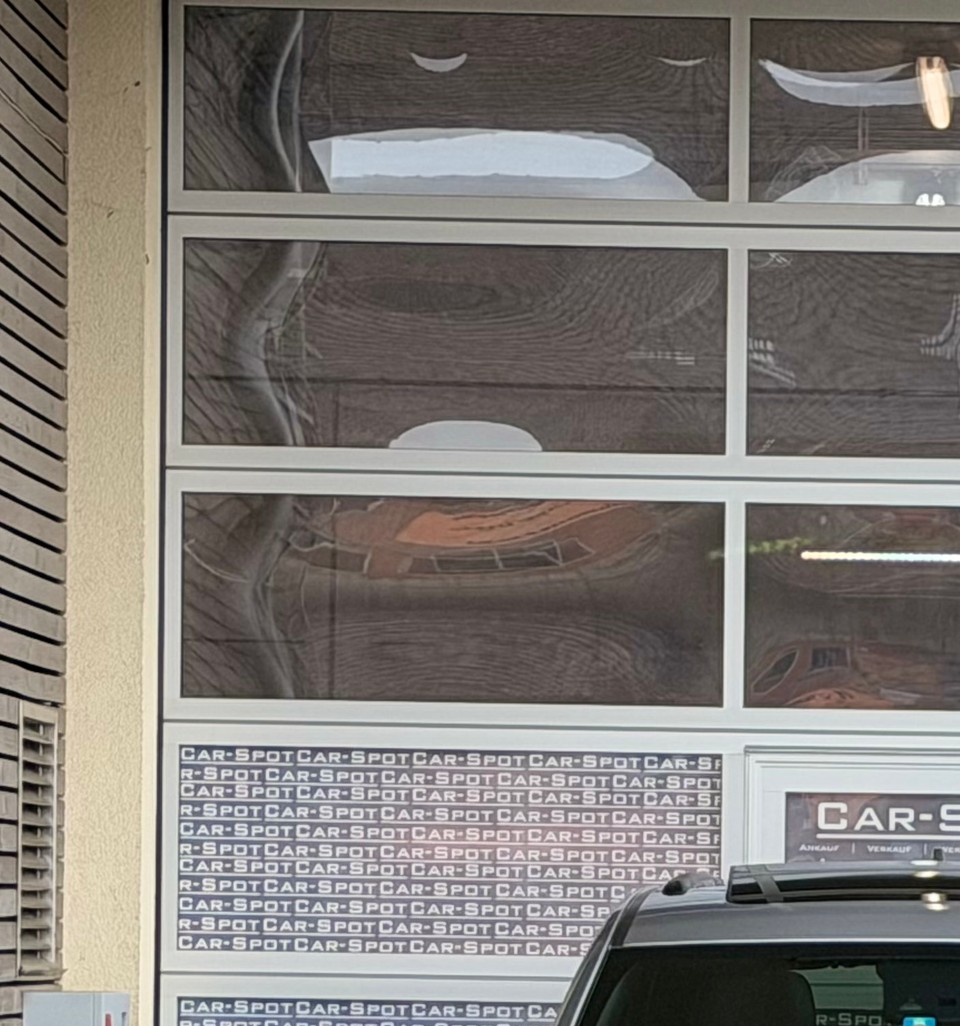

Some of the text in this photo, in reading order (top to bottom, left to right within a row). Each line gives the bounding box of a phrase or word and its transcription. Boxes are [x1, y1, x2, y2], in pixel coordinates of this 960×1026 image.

[181, 747, 294, 762] CAR-SPOT
[296, 749, 410, 764] CAR-SPOT
[412, 752, 526, 767] CAR-SPOT
[528, 754, 641, 769] CAR-SPOT
[181, 766, 263, 781] R-SPOT
[265, 768, 378, 783] CAR-SPOT
[381, 770, 494, 785] CAR-SPOT
[496, 772, 610, 787] CAR-SPOT
[181, 783, 294, 798] CAR-SPOT
[296, 785, 409, 800] CAR-SPOT
[412, 788, 525, 803] CAR-SPOT
[527, 790, 641, 805] CAR-SPOT
[180, 802, 262, 817] R-SPOT
[265, 804, 378, 819] CAR-SPOT
[380, 806, 494, 821] CAR-SPOT
[496, 808, 609, 823] CAR-SPOT
[180, 822, 640, 843] CAR-SPOT CAR-SPOT CAR-SPOT CAR-SPOT
[180, 841, 262, 855] R-SPOT
[264, 842, 377, 857] CAR-SPOT
[380, 845, 493, 860] CAR-SPOT
[495, 847, 609, 862] CAR-SPOT
[180, 858, 293, 873] CAR-SPOT
[295, 860, 409, 875] CAR-SPOT
[411, 862, 524, 877] CAR-SPOT
[527, 865, 640, 880] CAR-SPOT
[179, 877, 261, 892] R-SPOT
[264, 879, 377, 894] CAR-SPOT
[379, 881, 493, 896] CAR-SPOT
[495, 883, 608, 898] CAR-SPOT
[179, 897, 292, 912] CAR-SPOT
[295, 899, 408, 914] CAR-SPOT
[410, 901, 524, 916] CAR-SPOT
[179, 916, 261, 931] R-SPOT
[263, 918, 377, 933] CAR-SPOT
[379, 920, 492, 935] CAR-SPOT
[178, 936, 523, 955] CAR-SPOT CAR-SPOT CAR-SPOT
[181, 999, 525, 1018] CAR-SPOT CAR-SPOT CAR-SPOT
[815, 1012, 891, 1026] R-SPO
